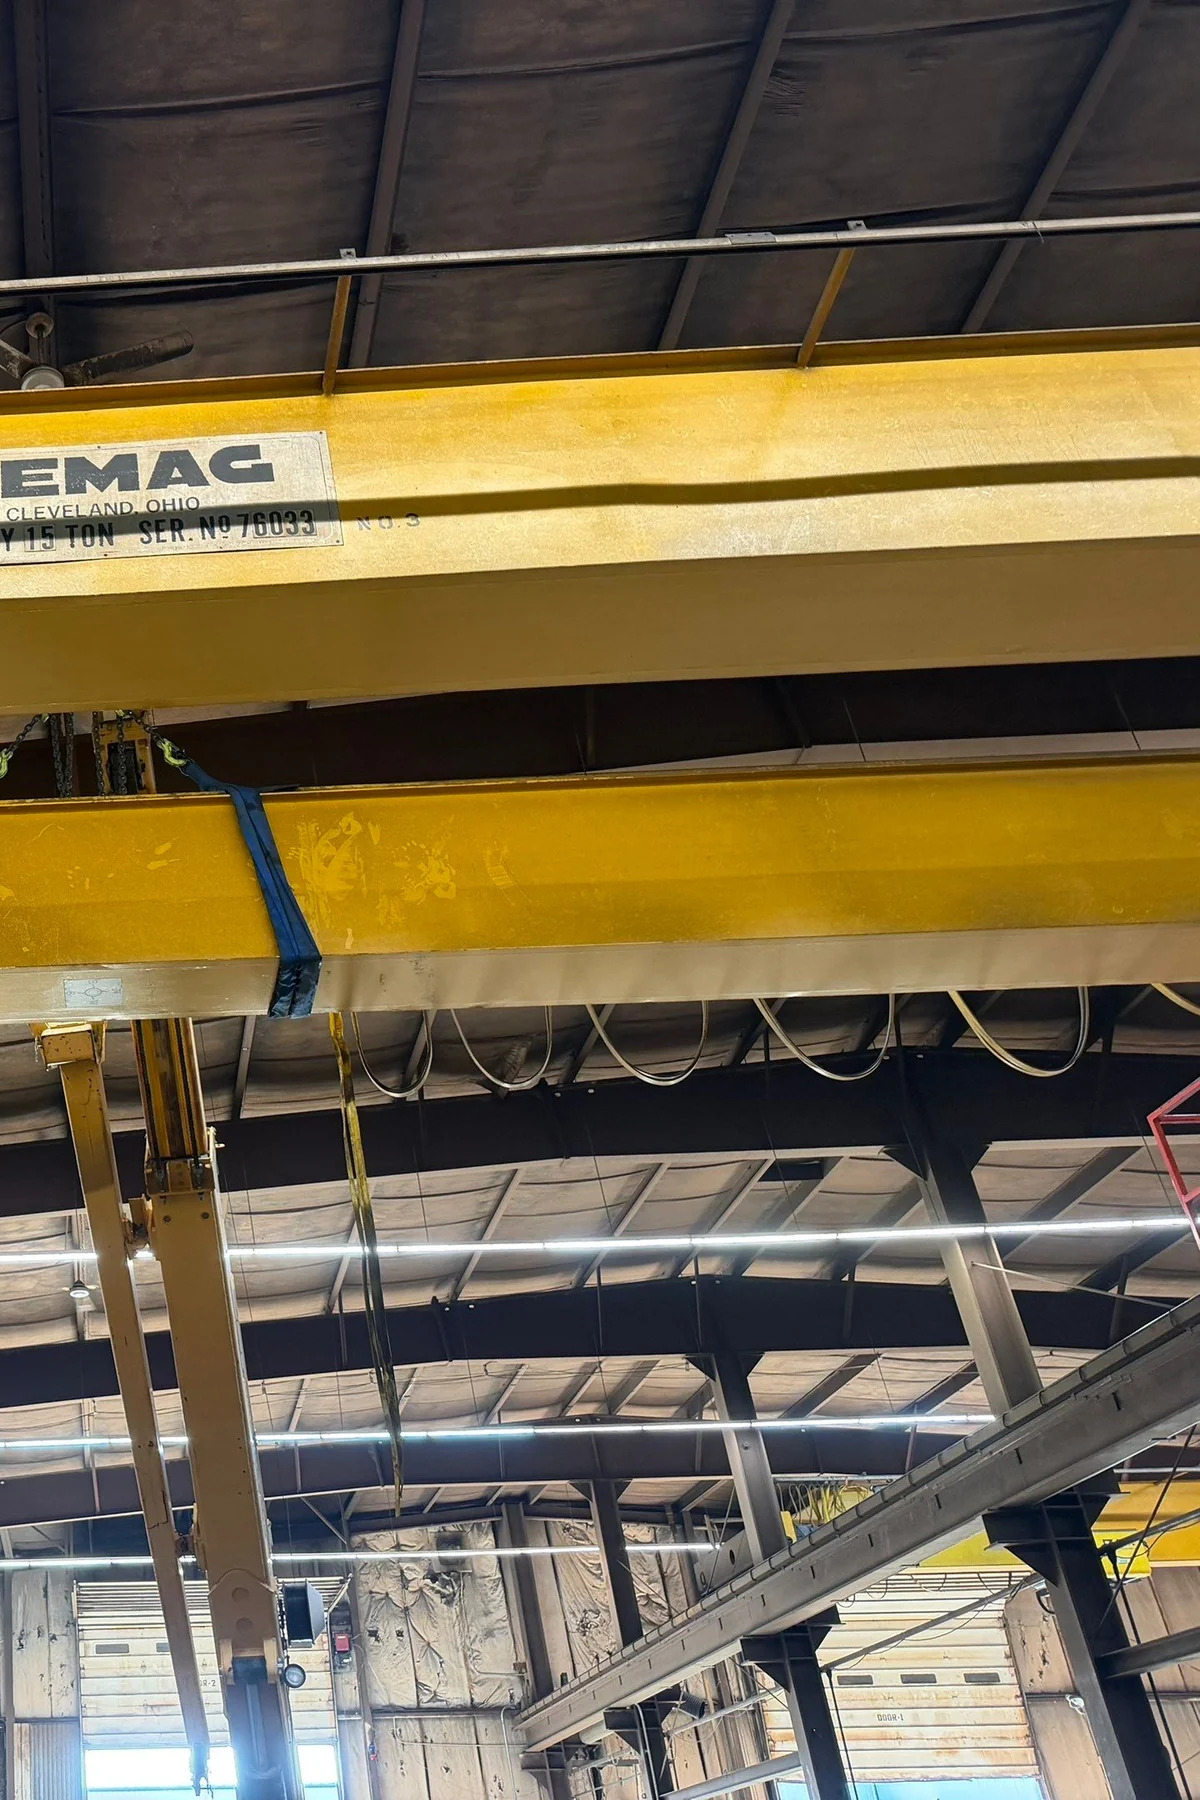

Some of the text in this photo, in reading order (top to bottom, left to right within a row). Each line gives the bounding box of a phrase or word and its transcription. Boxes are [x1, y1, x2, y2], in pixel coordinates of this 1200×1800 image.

[6, 496, 200, 521] CLEVELAND, OHIO
[26, 525, 55, 550] 15
[65, 522, 115, 548] TON
[139, 518, 194, 545] SER.
[237, 509, 316, 538] 76033
